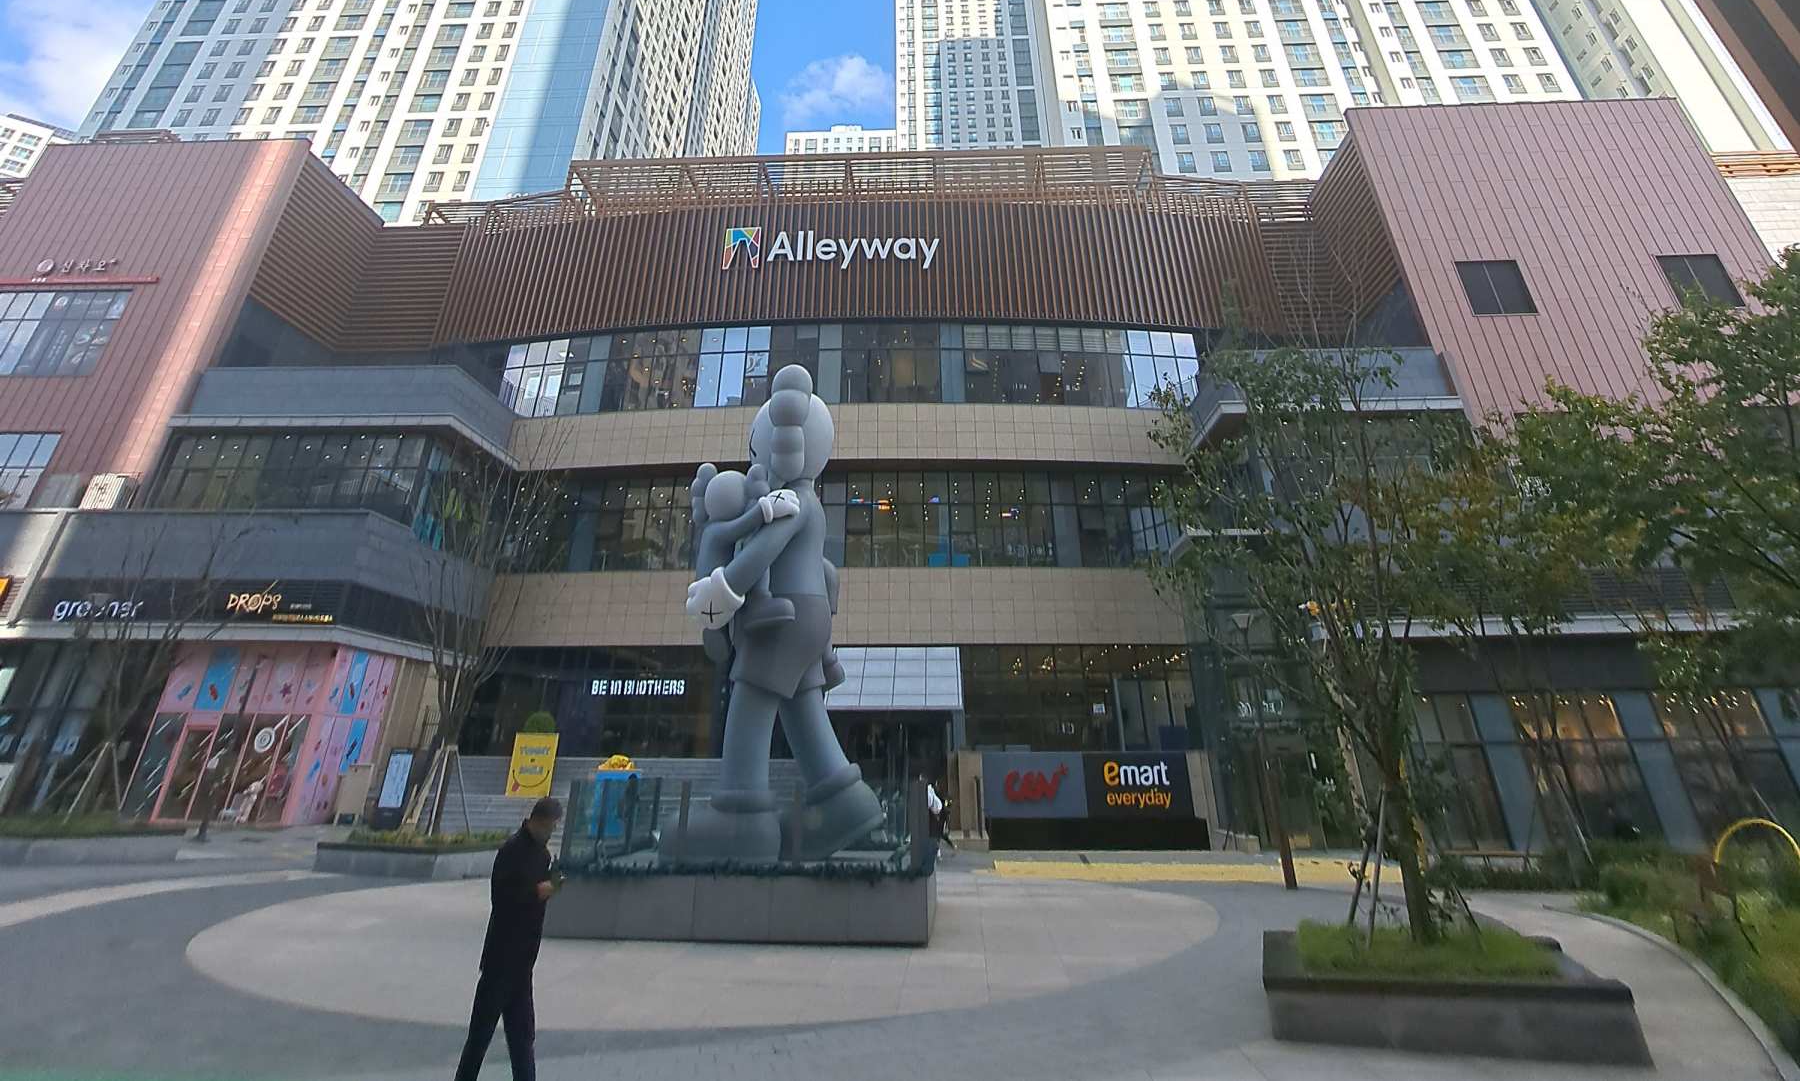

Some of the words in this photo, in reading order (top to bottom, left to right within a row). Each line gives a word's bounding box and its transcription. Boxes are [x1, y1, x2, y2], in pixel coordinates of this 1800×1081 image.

[767, 230, 940, 270] Alleyway
[226, 592, 282, 615] DROPS
[591, 679, 608, 695] BE
[1103, 760, 1170, 787] emart
[1106, 788, 1172, 809] everyday
